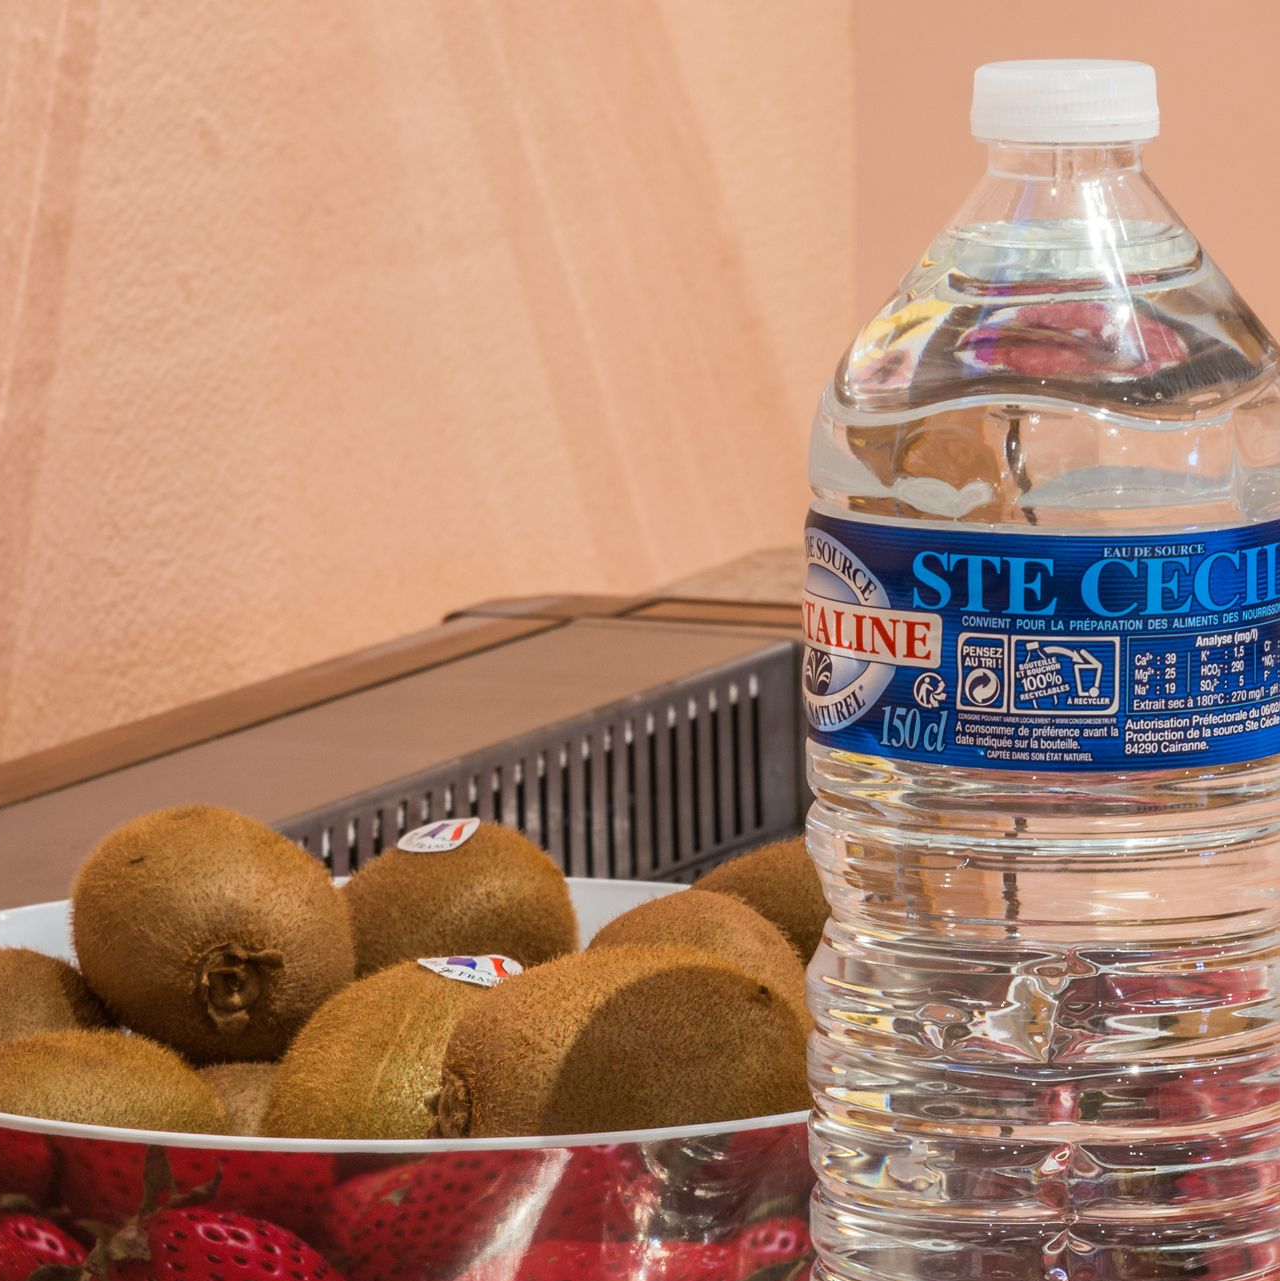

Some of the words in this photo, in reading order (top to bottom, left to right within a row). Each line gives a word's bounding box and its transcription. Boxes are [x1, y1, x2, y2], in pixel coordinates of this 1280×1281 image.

[1103, 545, 1132, 558] EAU
[1133, 545, 1153, 557] DE
[1154, 543, 1206, 556] SOURCE
[816, 538, 877, 602] SOURCE
[911, 550, 1058, 616] STE
[961, 615, 1012, 629] CONVIENT
[1016, 619, 1046, 631] POUR
[1051, 620, 1065, 631] LA
[1069, 616, 1143, 631] PRÉPARATION
[1147, 618, 1169, 631] DES
[1173, 615, 1219, 630] ALIMENTS
[1222, 612, 1239, 624] DES
[802, 599, 932, 661] TALINE
[1195, 631, 1233, 648] Analyse
[1233, 628, 1259, 645] (mg/l)
[962, 645, 1004, 658] PENSEZ
[1164, 653, 1177, 665] 39
[964, 657, 979, 667] AU
[1018, 657, 1058, 670] BOUTEILLE
[1231, 661, 1244, 673] 290
[1016, 669, 1025, 678] ET
[1026, 663, 1062, 675] BOUCHON
[1164, 668, 1176, 679] 25
[1021, 672, 1063, 692] 100%
[1164, 683, 1176, 694] 19
[1238, 676, 1245, 687] 5
[1019, 684, 1070, 701] RECYCLABLES
[1133, 698, 1166, 711] Extrait
[1167, 699, 1185, 709] sec
[1187, 697, 1194, 707] à
[1197, 693, 1225, 706] 180°C
[1231, 690, 1247, 702] 270
[1248, 686, 1265, 700] mg/l
[958, 712, 981, 721] CONSIGNE
[981, 714, 1002, 723] POUVANT
[1020, 716, 1051, 724] LOCALEMENT
[1125, 718, 1190, 730] Autorisation
[1192, 709, 1248, 726] Préfectorale
[1249, 706, 1260, 718] du
[879, 705, 921, 749] 150
[922, 710, 949, 752] cl
[955, 721, 963, 732] A
[964, 723, 1016, 735] consommer
[1017, 726, 1030, 737] de
[1032, 725, 1080, 738] préférence
[1082, 727, 1108, 737] avant
[1110, 726, 1119, 737] la
[1125, 729, 1185, 743] Production
[1186, 728, 1200, 739] de
[1202, 727, 1211, 737] la
[1213, 724, 1244, 737] source
[1245, 720, 1259, 732] Ste
[1260, 714, 1280, 729] Cécile
[955, 734, 974, 745] date
[975, 735, 1013, 748] indiquée
[1014, 739, 1029, 748] sur
[1030, 739, 1039, 749] la
[1040, 739, 1081, 750] bouteille.
[1125, 743, 1158, 754] 84290
[1160, 740, 1209, 753] Cairanne.
[986, 749, 1011, 760] CAPTÉE
[1012, 751, 1030, 761] DANS
[1031, 752, 1045, 761] SON
[1046, 751, 1062, 761] ÉTAT
[1063, 753, 1093, 762] NATUREL
